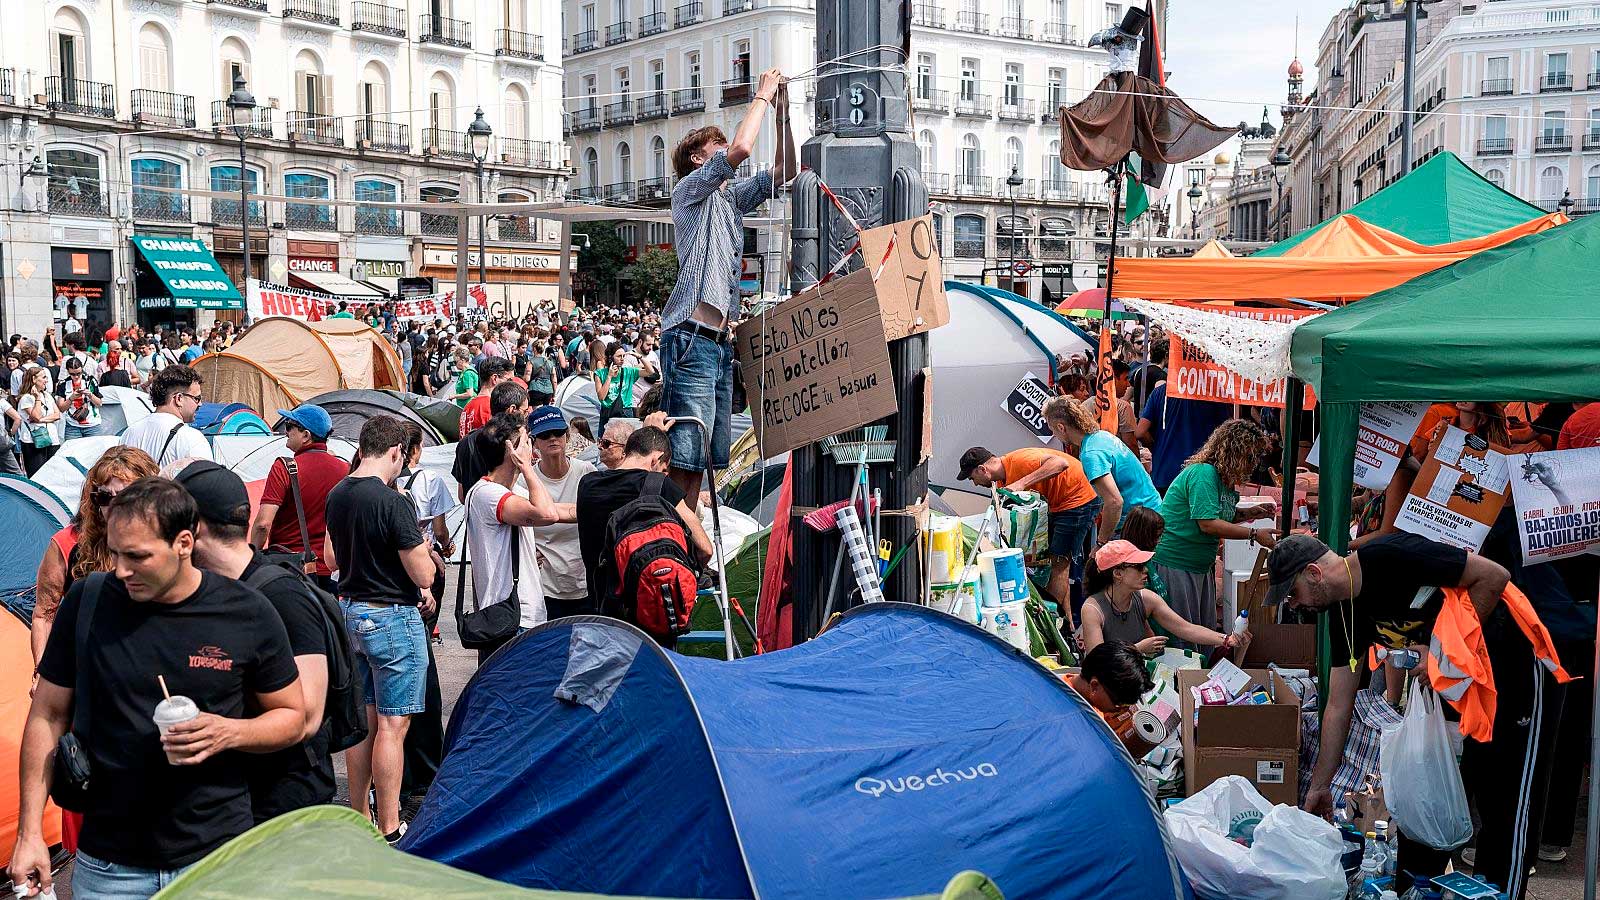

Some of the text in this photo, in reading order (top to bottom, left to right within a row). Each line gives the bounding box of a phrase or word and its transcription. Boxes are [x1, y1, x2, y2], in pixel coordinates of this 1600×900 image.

[141, 239, 202, 252] CHANGE
[153, 260, 215, 271] TRANSFER
[289, 259, 333, 271] CHANGE
[492, 254, 508, 267] DE
[514, 255, 549, 268] DIEGO
[168, 279, 229, 291] CAMBIO
[140, 298, 171, 308] CHANGE
[750, 306, 839, 360] Esto NO es
[781, 338, 849, 382] botellón
[1177, 366, 1235, 400] CONTRA
[1239, 376, 1259, 402] LA
[763, 372, 878, 428] RECOGE tu basura
[1014, 401, 1047, 430] STOP
[1359, 428, 1377, 444] NOS
[1375, 436, 1400, 454] ROBA
[1409, 497, 1422, 507] QUE
[1422, 500, 1434, 512] LAS
[1434, 505, 1465, 526] VENTANAS
[1464, 520, 1474, 529] DE
[1434, 515, 1458, 530] HABLEN
[1523, 511, 1528, 520] 5
[1528, 508, 1545, 519] ABRIL
[1552, 505, 1569, 516] 12:00
[1569, 504, 1574, 514] H
[1525, 509, 1600, 534] BAJEMOS LO
[1528, 524, 1600, 551] ALQUILERE
[854, 762, 999, 798] Quechua
